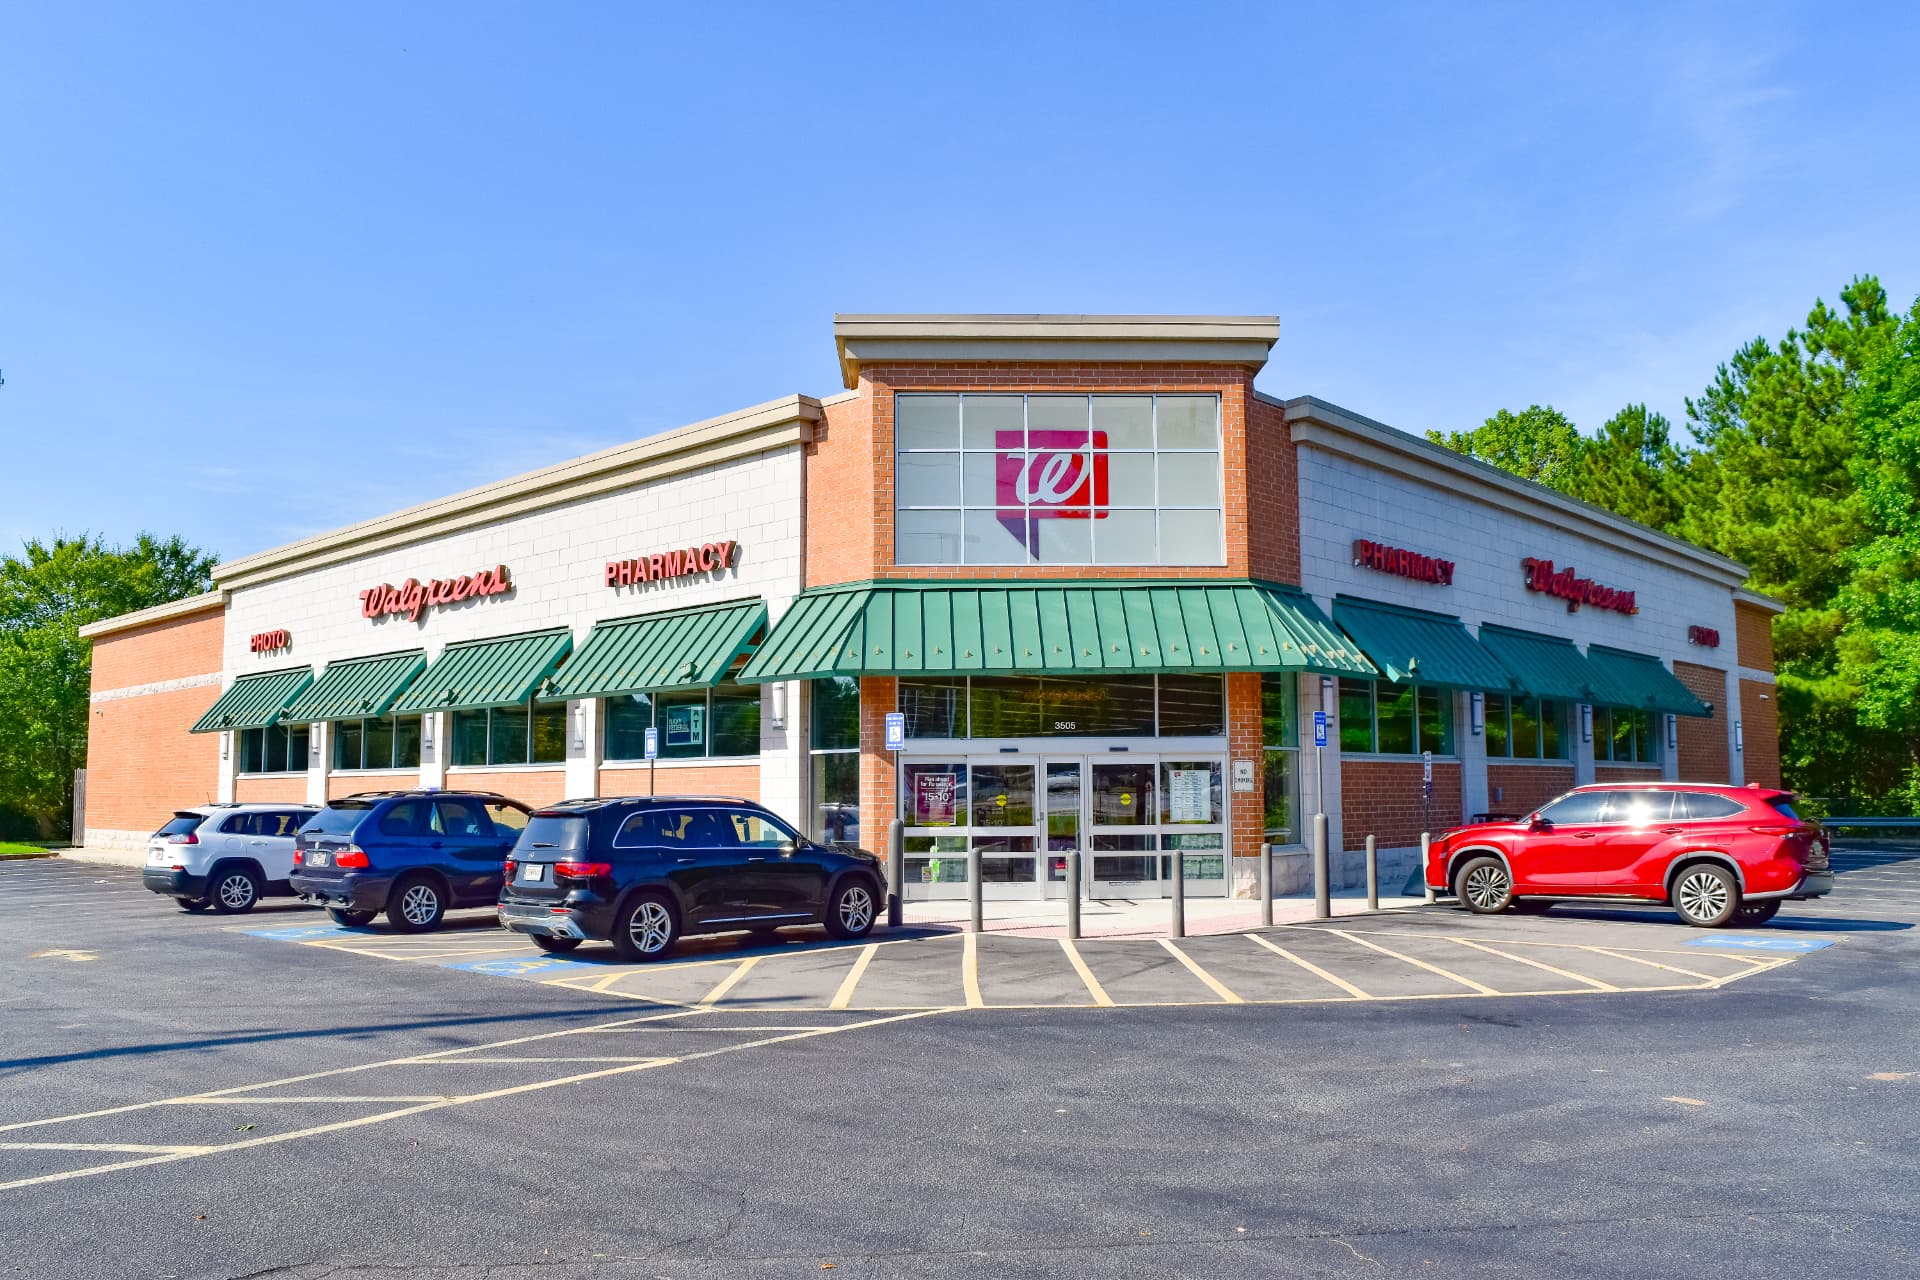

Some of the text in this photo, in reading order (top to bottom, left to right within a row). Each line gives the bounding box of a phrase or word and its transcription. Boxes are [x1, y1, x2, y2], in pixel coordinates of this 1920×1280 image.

[605, 540, 736, 587] PHARMACY
[1354, 539, 1455, 585] PHARMACY
[360, 565, 511, 622] Walgreens
[1522, 557, 1638, 614] Walgreens
[251, 629, 289, 652] PHOTO
[1054, 721, 1076, 730] 3505
